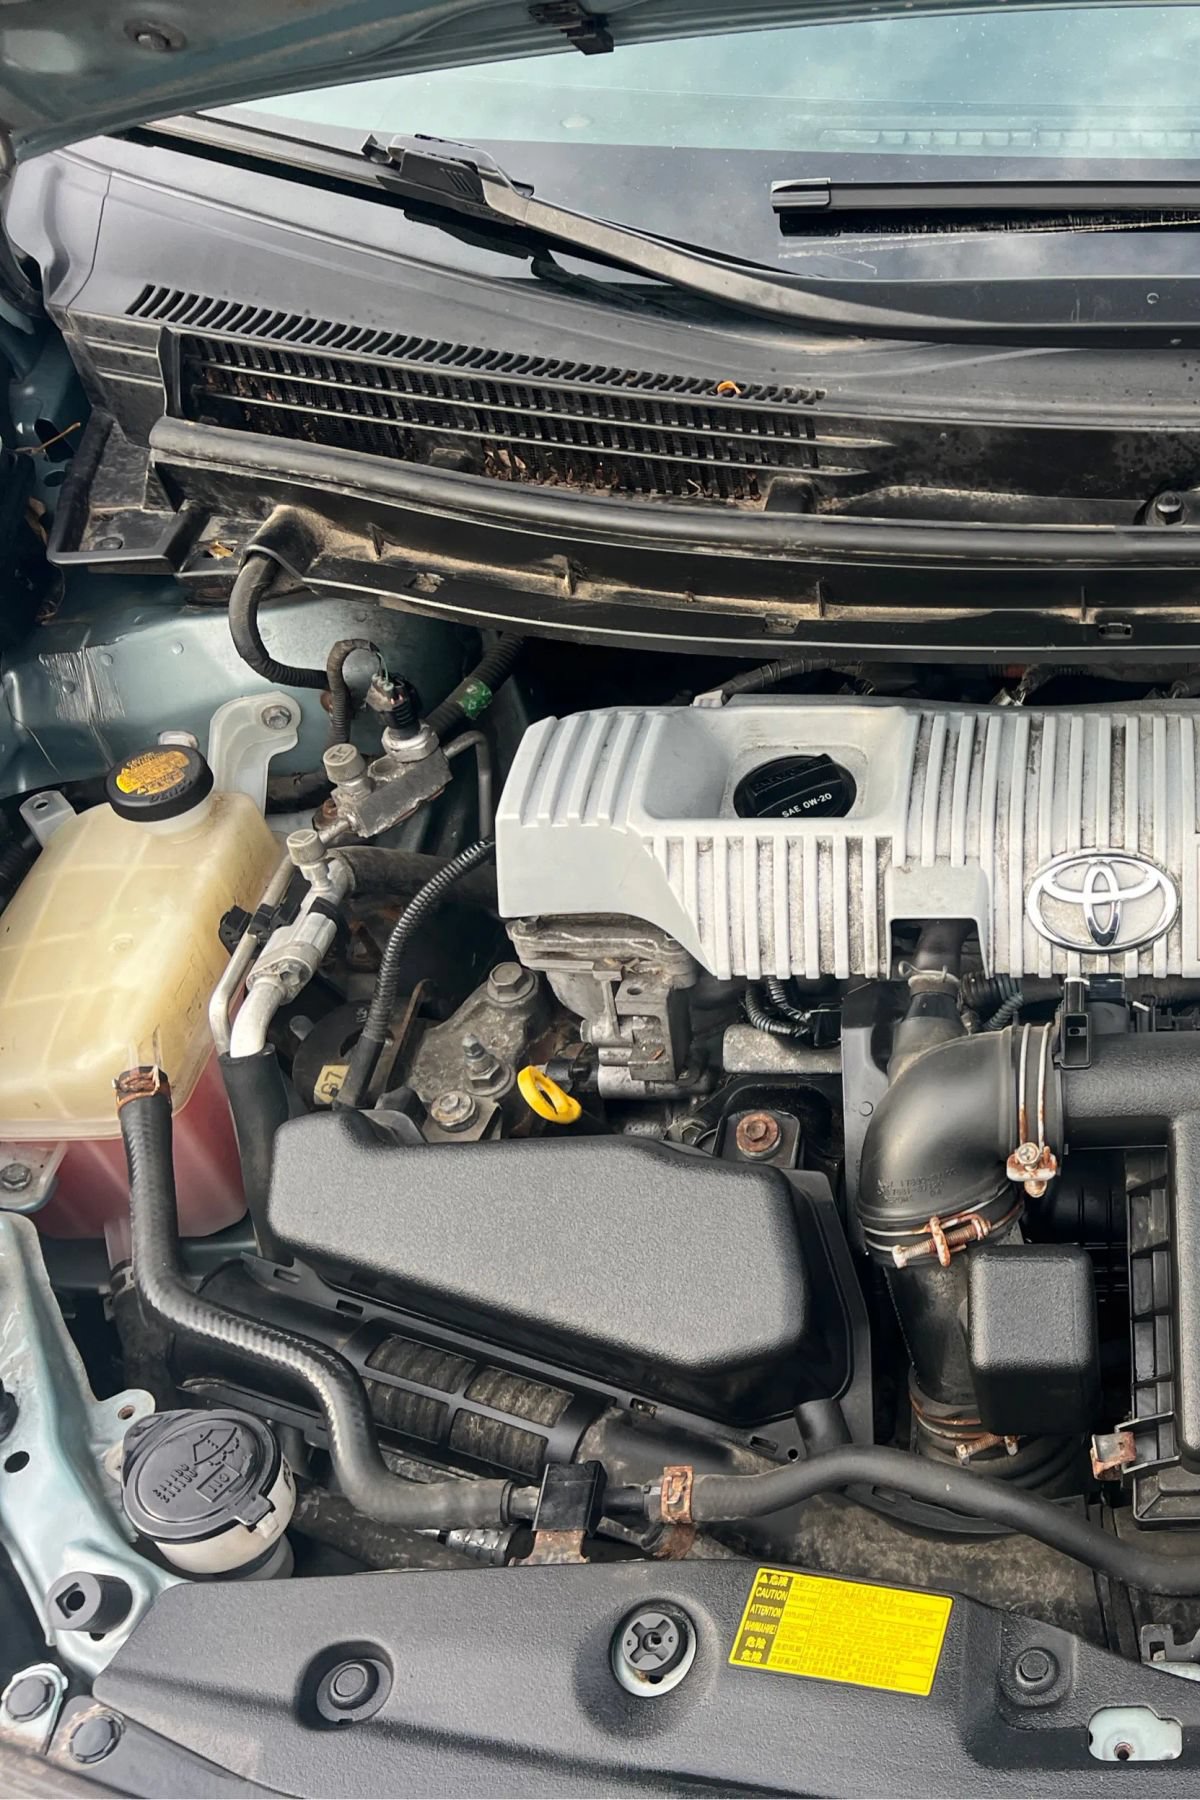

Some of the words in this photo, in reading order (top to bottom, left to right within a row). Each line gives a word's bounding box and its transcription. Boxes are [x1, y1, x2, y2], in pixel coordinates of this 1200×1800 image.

[781, 806, 801, 818] SAE
[803, 792, 833, 809] 0W-20
[755, 1586, 788, 1602] CAUTION
[749, 1604, 783, 1619] ATTENTION
